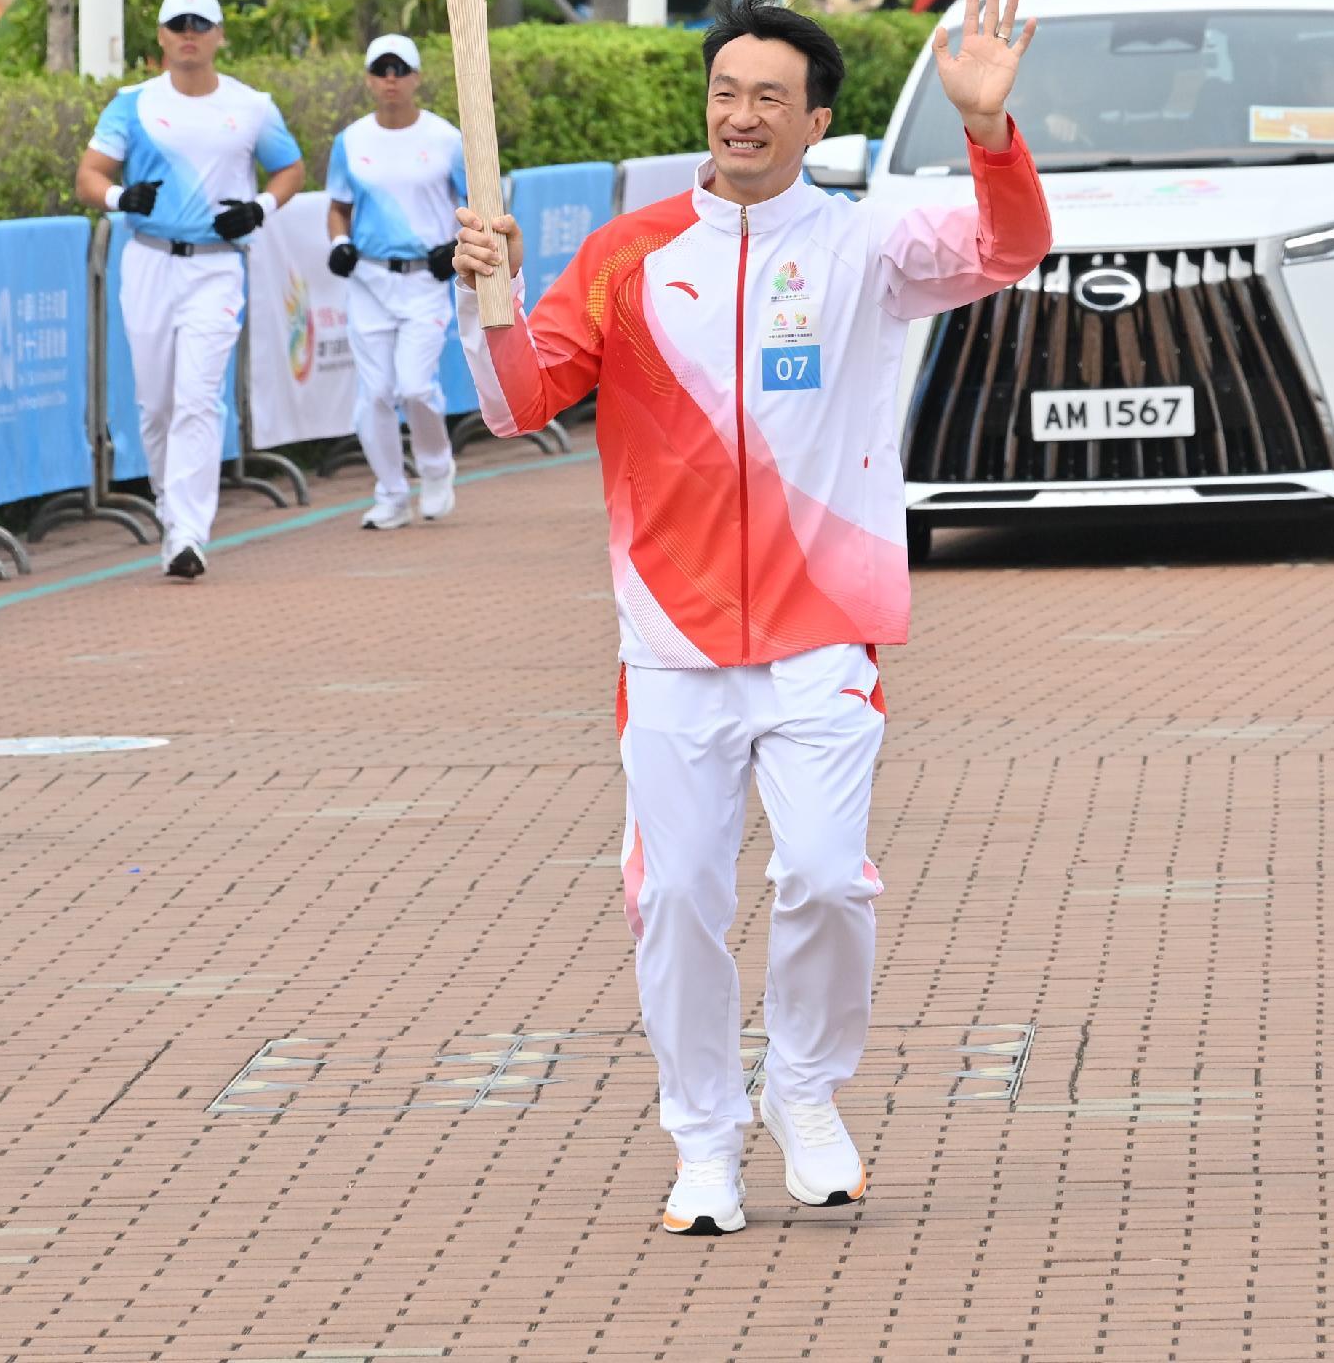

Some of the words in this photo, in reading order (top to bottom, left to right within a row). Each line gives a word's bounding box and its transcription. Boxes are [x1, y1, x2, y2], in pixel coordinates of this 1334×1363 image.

[776, 356, 808, 381] 07
[1045, 401, 1087, 429] AM
[1105, 398, 1182, 428] 1567
